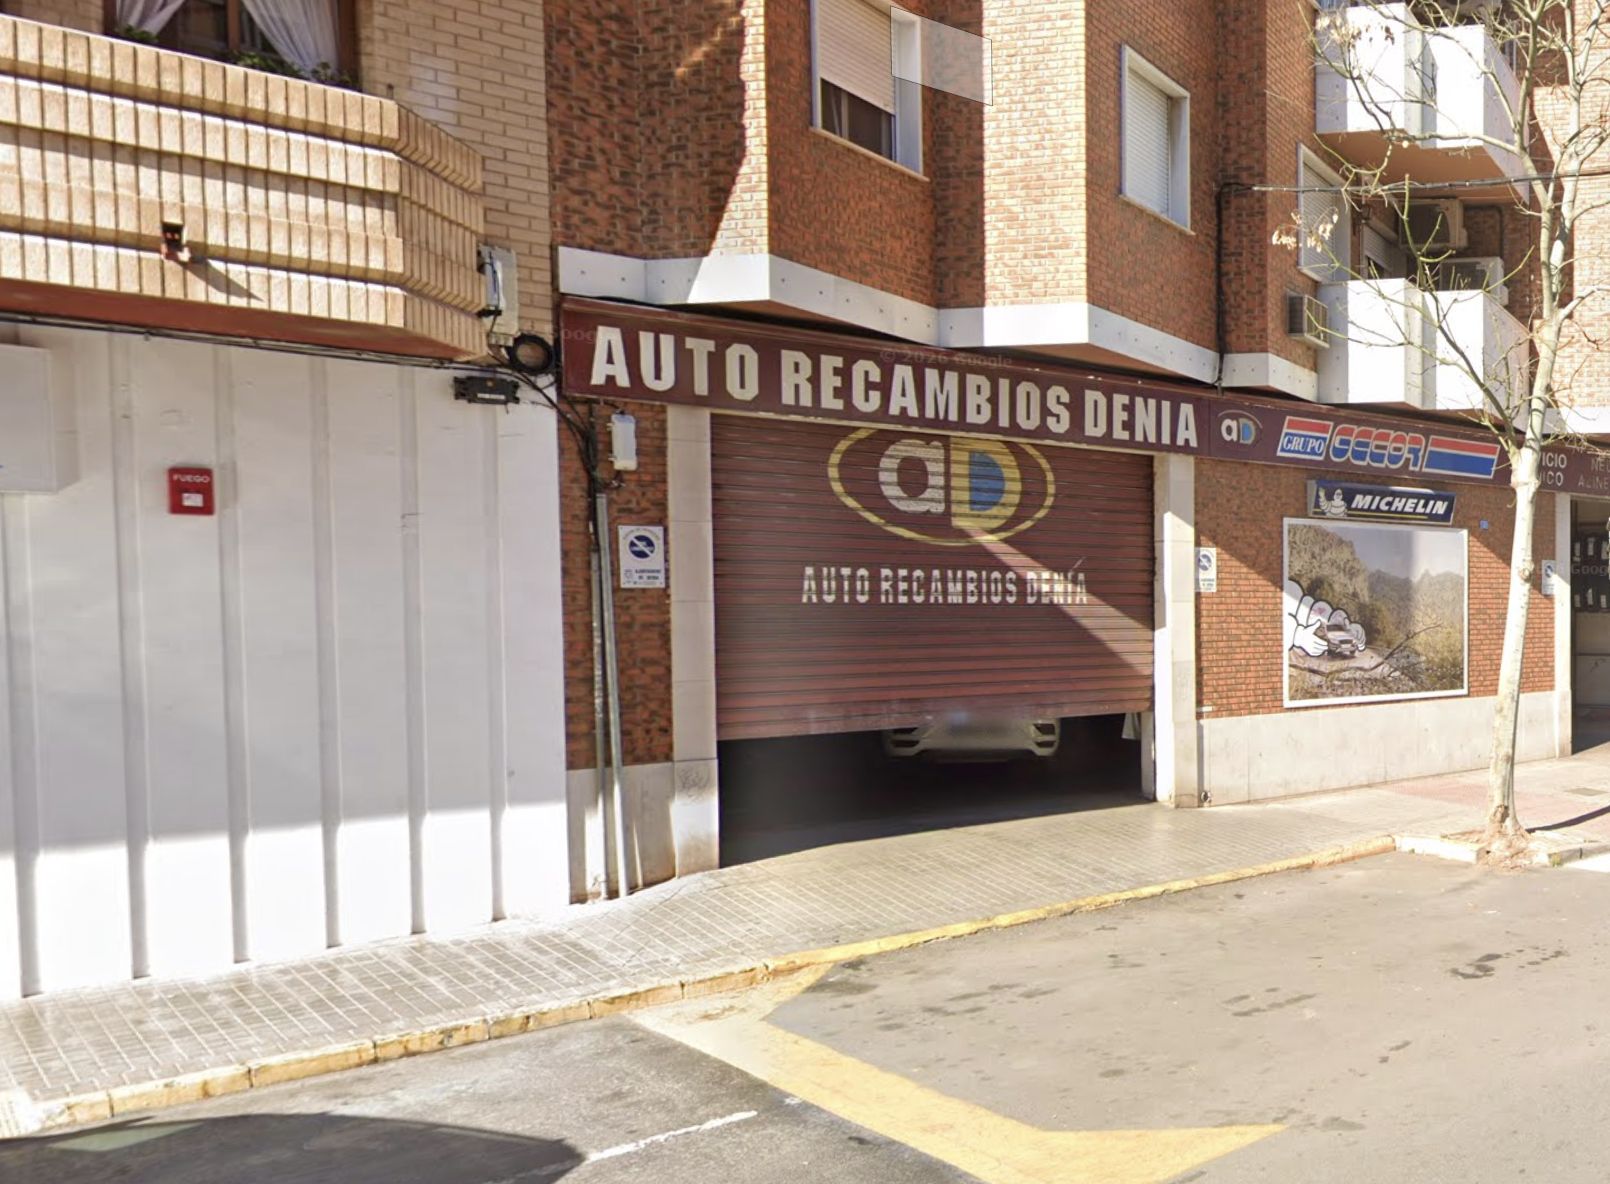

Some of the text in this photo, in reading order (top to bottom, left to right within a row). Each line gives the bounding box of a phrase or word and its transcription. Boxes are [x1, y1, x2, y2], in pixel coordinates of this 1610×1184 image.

[590, 326, 1198, 448] AUTO RECAMBIOS DENIA
[1283, 434, 1325, 454] GRUPO
[172, 474, 210, 483] FUEGO
[1350, 494, 1449, 515] MICHELIN
[801, 566, 870, 604] AUTO
[880, 567, 1017, 605] RECAMBIOS
